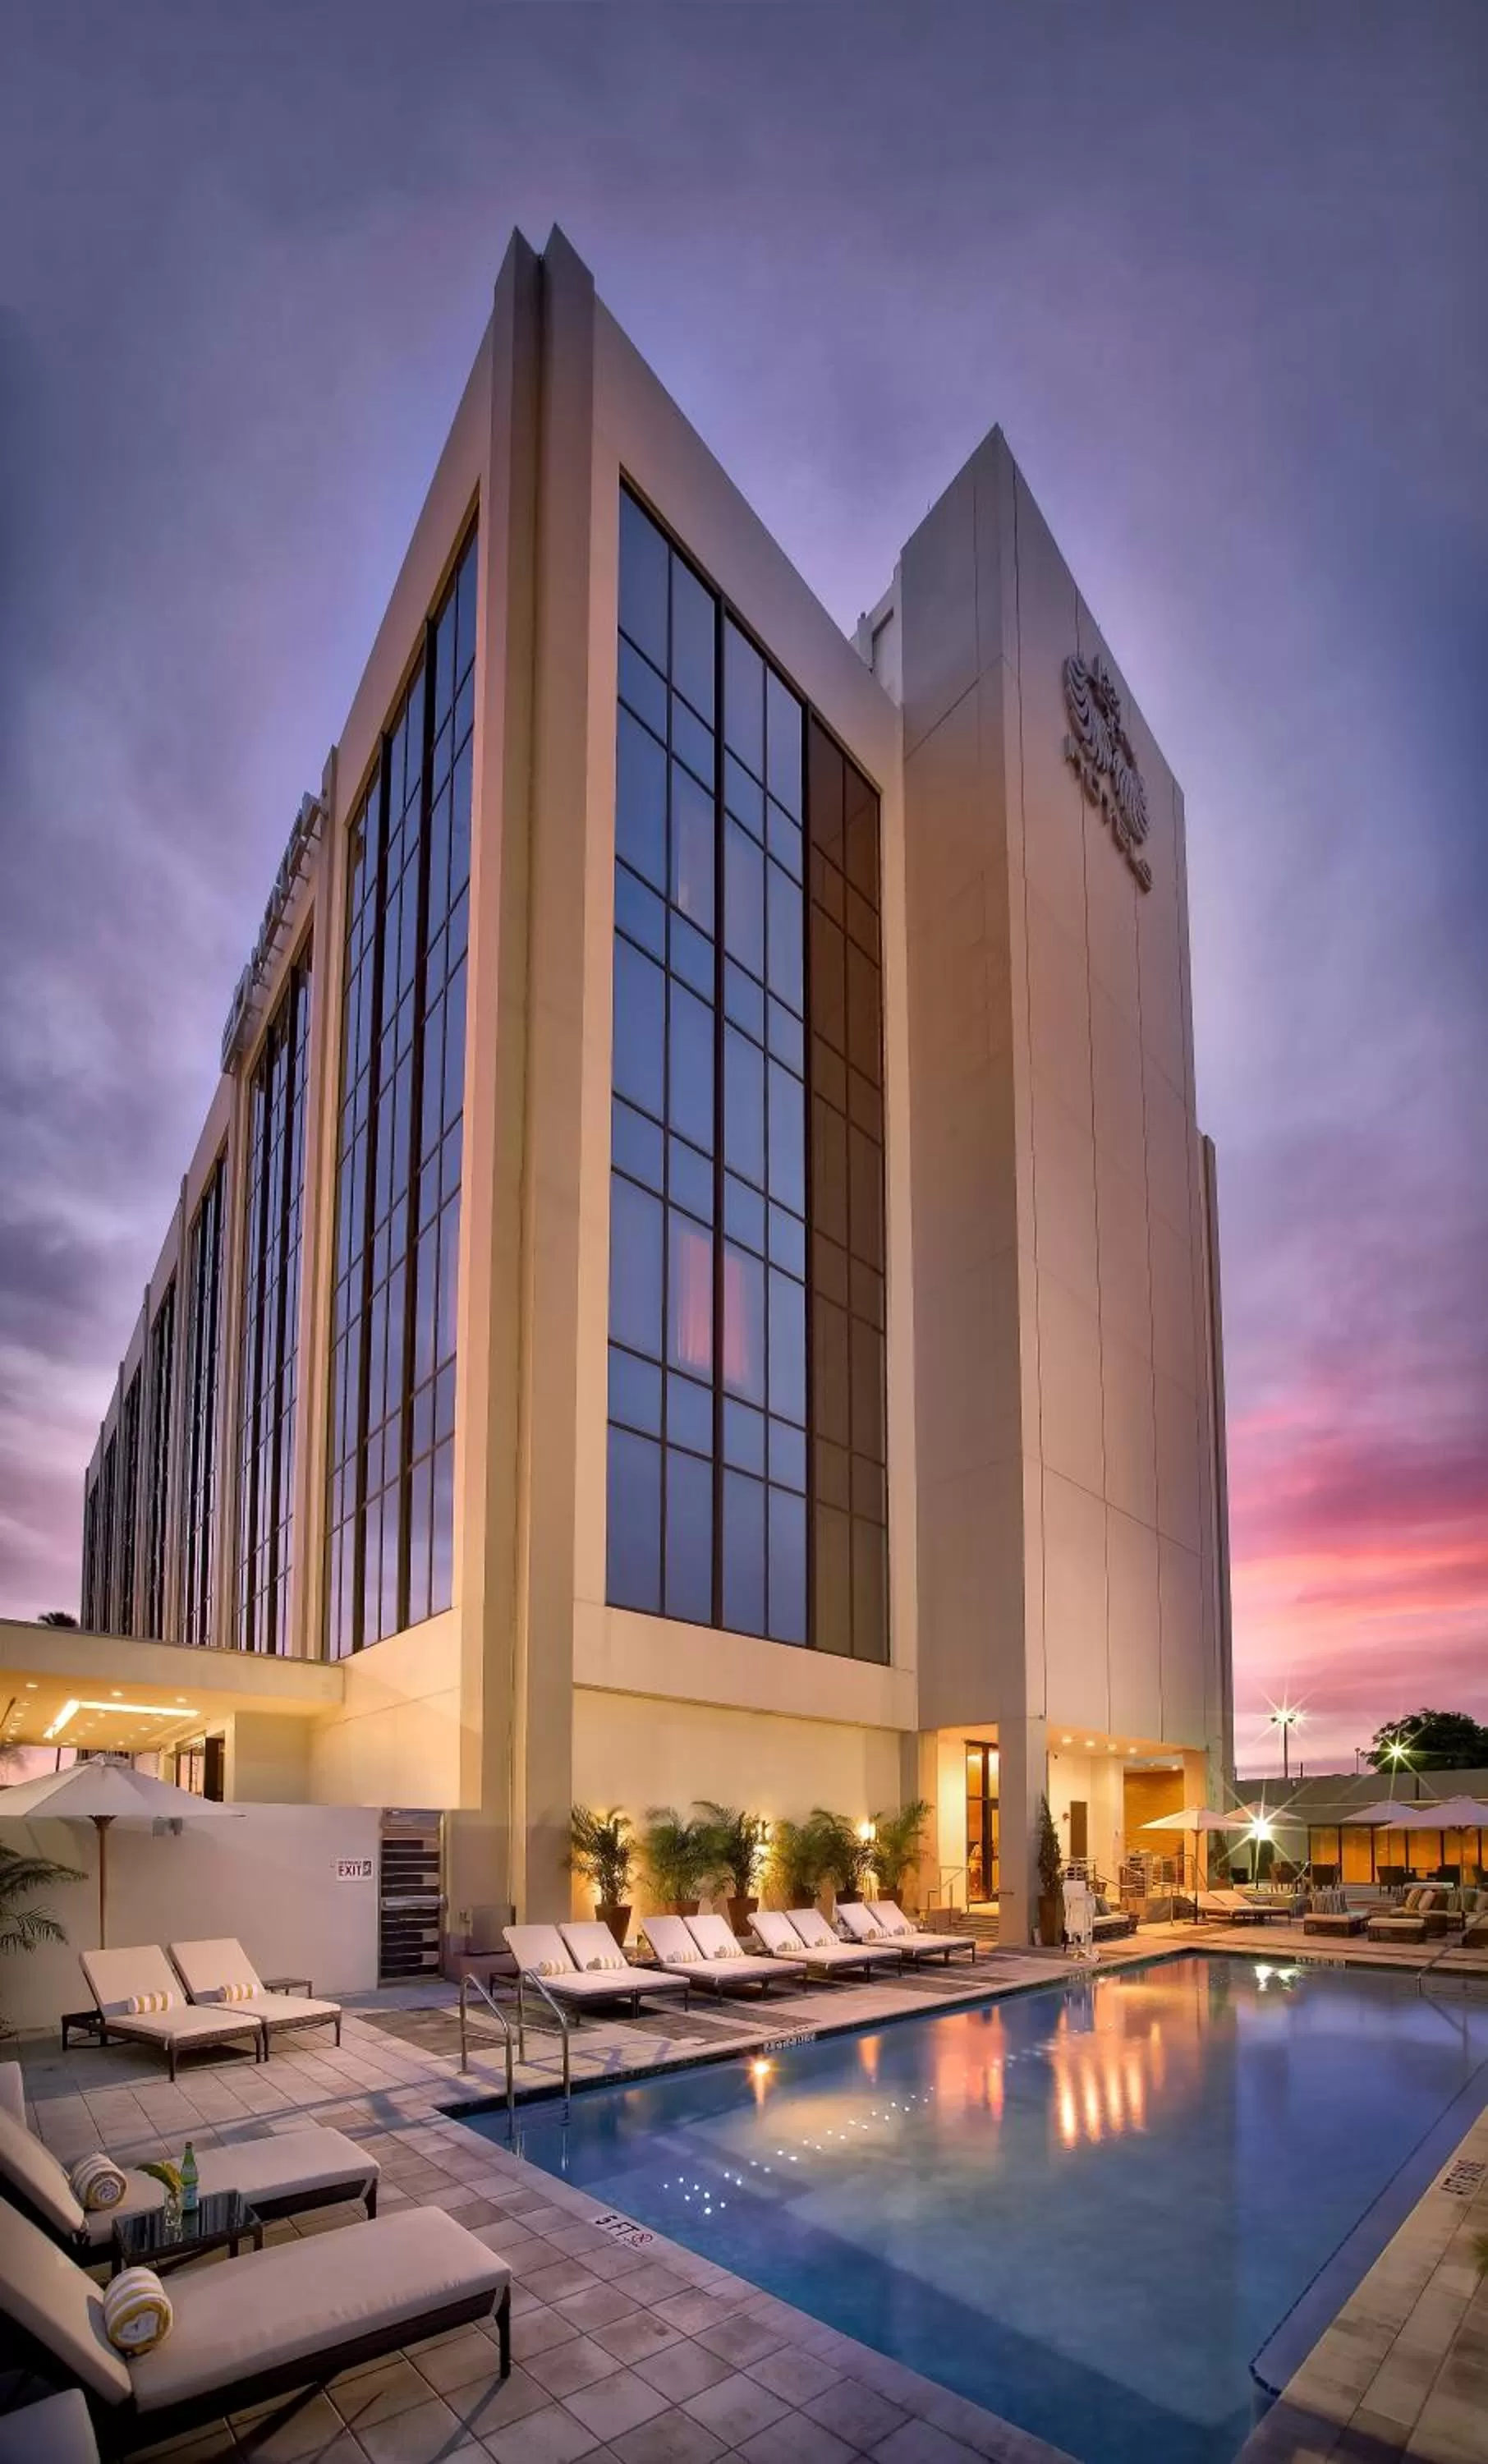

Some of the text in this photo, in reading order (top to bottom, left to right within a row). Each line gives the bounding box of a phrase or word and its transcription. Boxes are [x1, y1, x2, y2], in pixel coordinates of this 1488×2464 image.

[338, 1865, 361, 1877] EXIT
[595, 2215, 641, 2236] 5 FT
